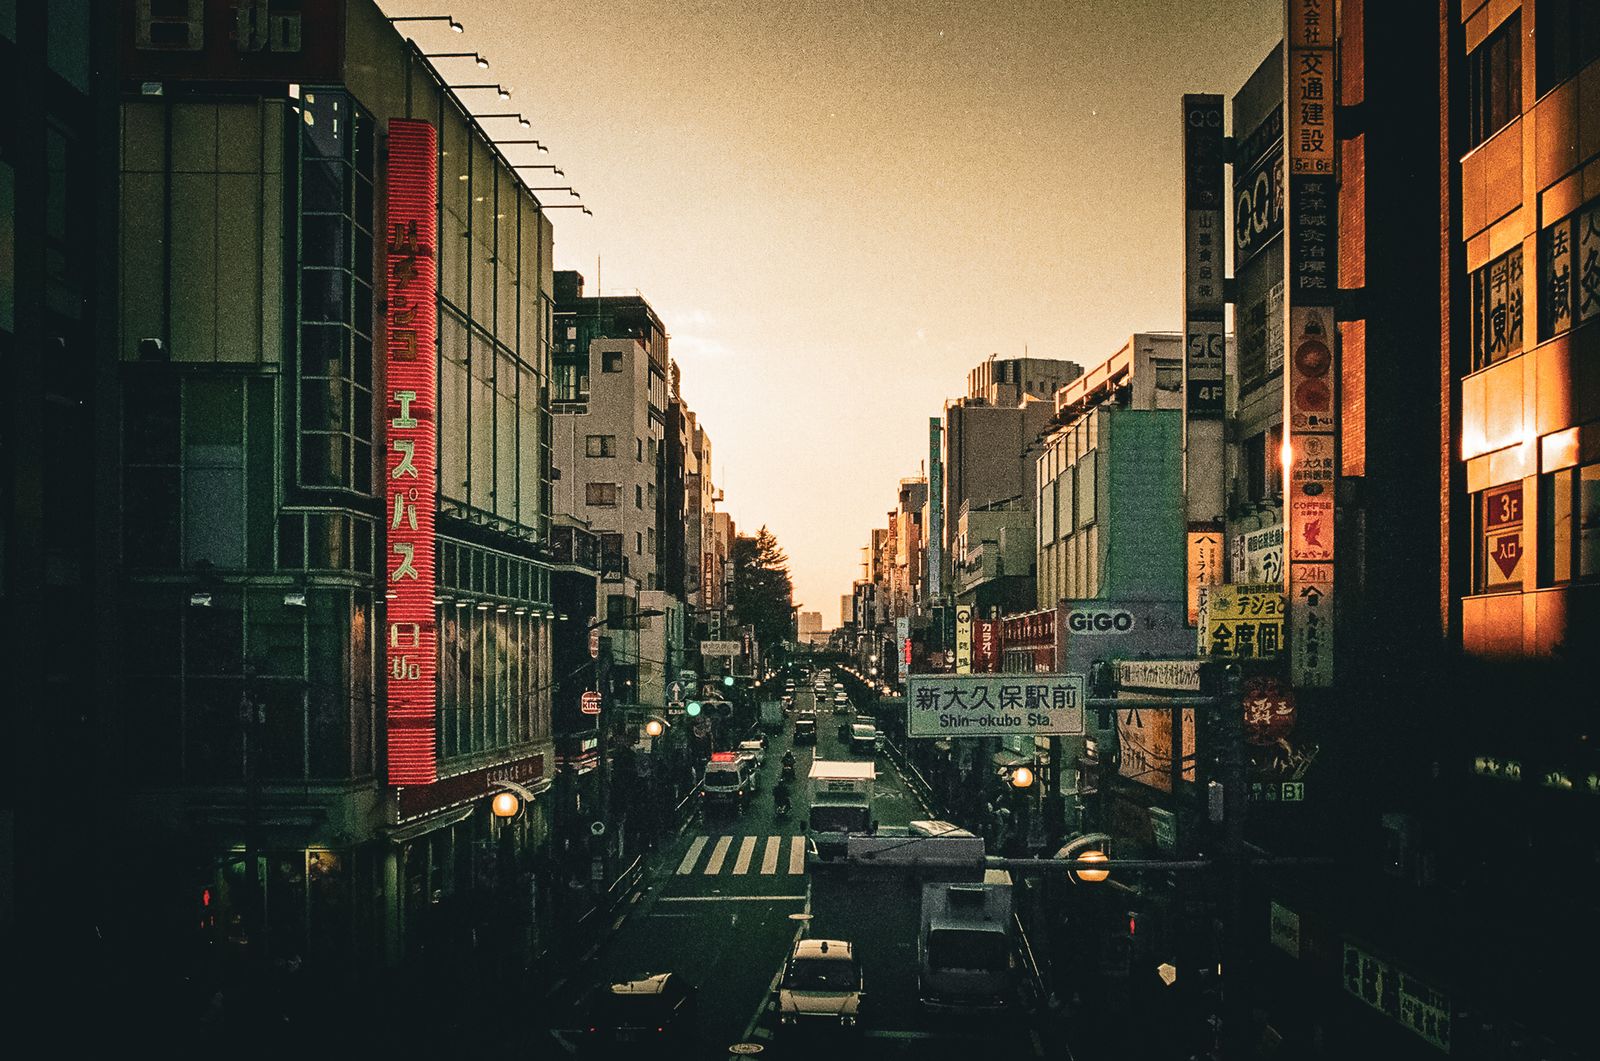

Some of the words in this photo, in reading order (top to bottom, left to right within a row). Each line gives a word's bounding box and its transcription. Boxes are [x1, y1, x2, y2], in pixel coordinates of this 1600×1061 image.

[1301, 53, 1324, 152] 交通建設
[1300, 183, 1327, 288] 東洋鍼灸治療院
[1199, 387, 1223, 400] 4F
[392, 390, 418, 581] エスパス
[1500, 494, 1519, 521] 3F
[1499, 543, 1516, 559] 入口
[1300, 567, 1326, 581] 24h
[1069, 612, 1132, 631] GiGO
[1210, 622, 1285, 658] 全席個
[916, 684, 1077, 711] 新大久保駅前
[940, 714, 1021, 727] Shin-okubo
[1028, 713, 1053, 727] Sta.
[1285, 784, 1302, 799] B1
